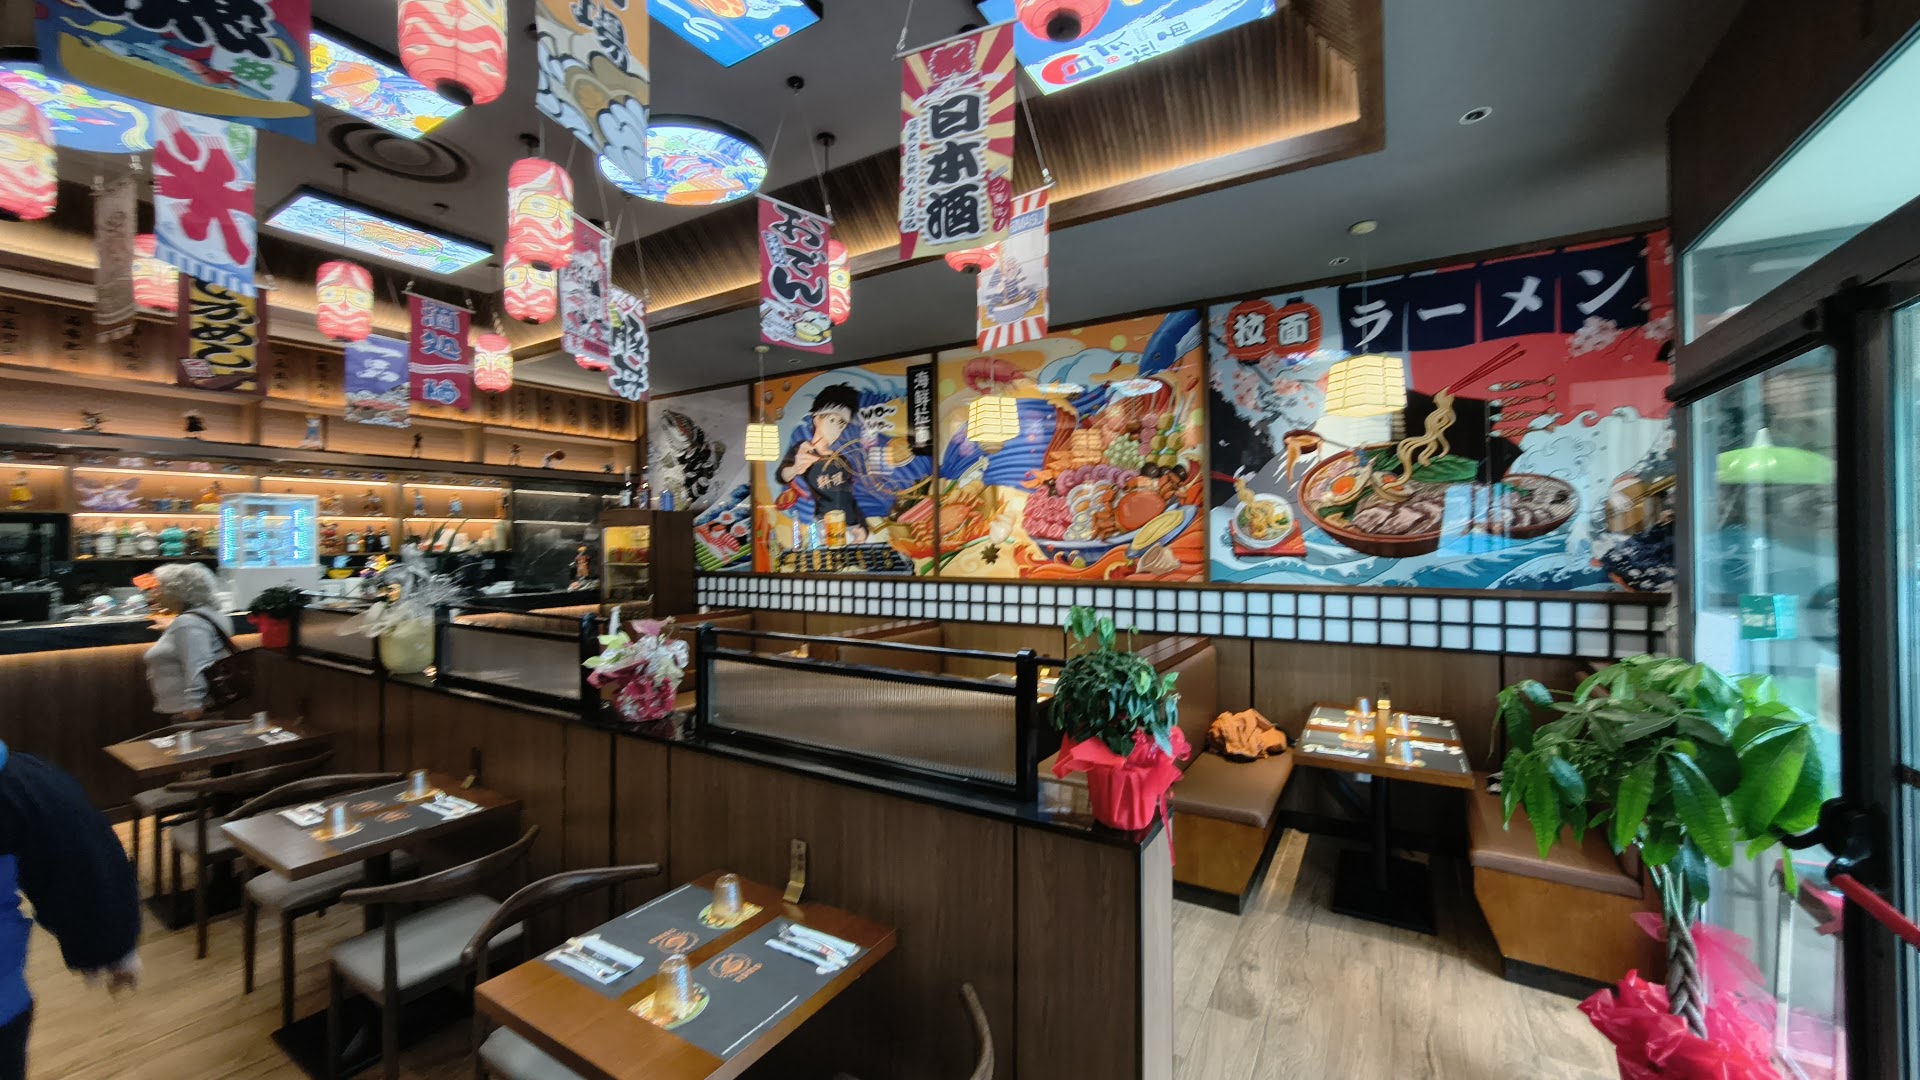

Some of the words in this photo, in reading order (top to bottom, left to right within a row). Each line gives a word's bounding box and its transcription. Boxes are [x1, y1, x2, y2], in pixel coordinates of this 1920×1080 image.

[926, 94, 982, 239] 日本酒
[770, 204, 828, 305] おでん
[1232, 312, 1309, 348] 拉面
[1350, 266, 1635, 347] ラーメン
